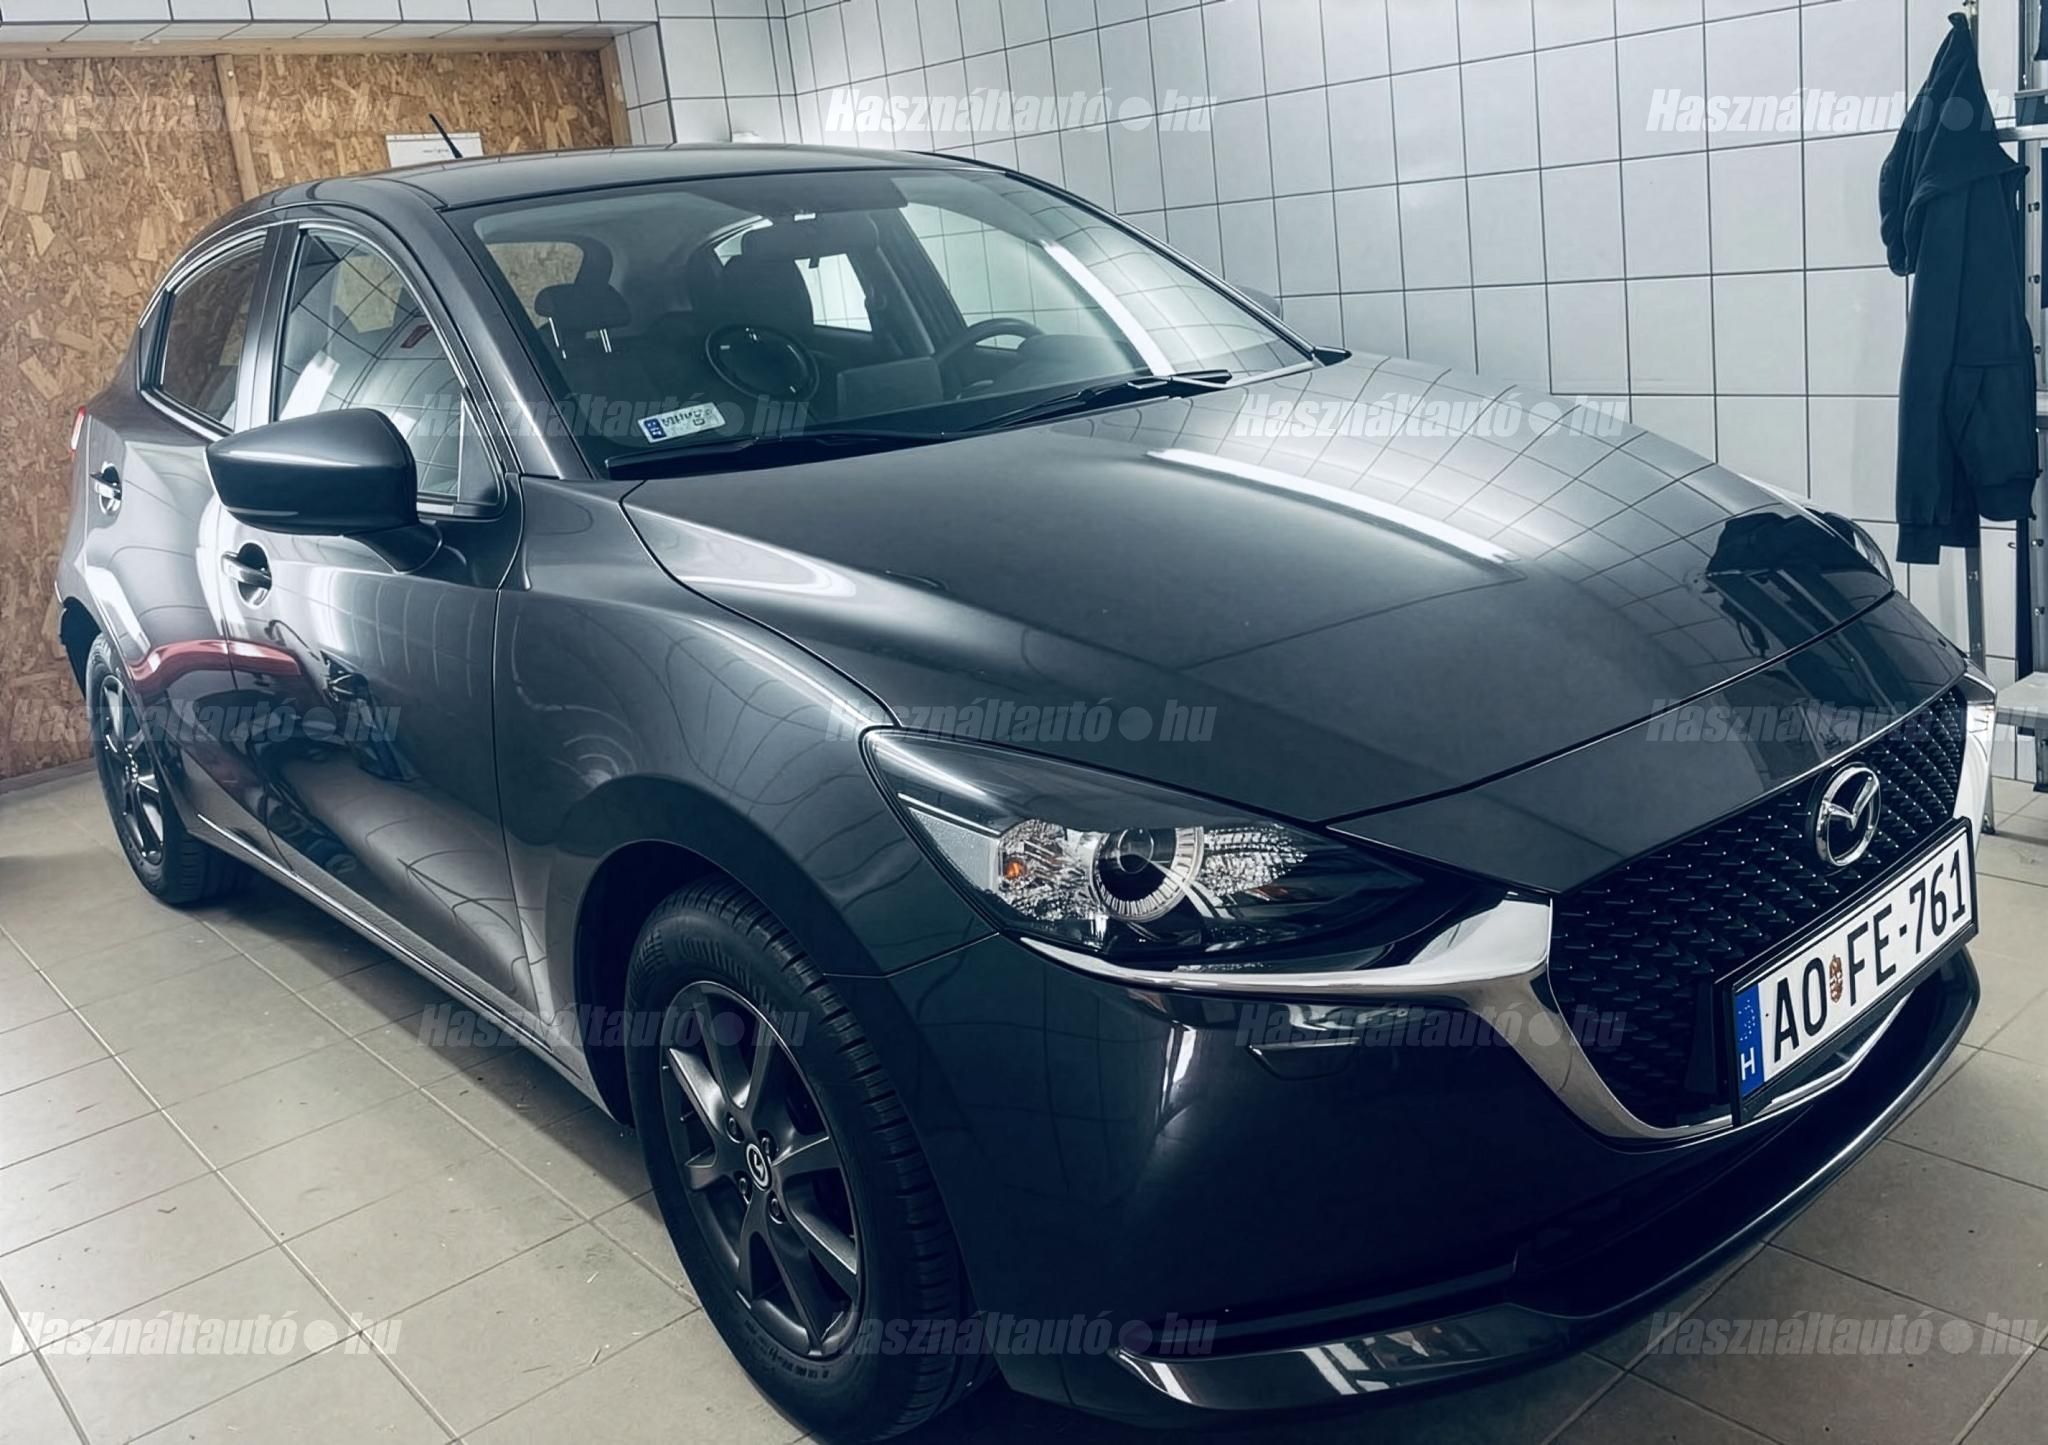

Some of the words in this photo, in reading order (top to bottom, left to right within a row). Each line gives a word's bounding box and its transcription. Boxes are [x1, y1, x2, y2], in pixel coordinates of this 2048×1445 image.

[1773, 957, 1828, 1063] AO
[1847, 849, 1966, 1008] FE-761
[1740, 1046, 1756, 1081] H
